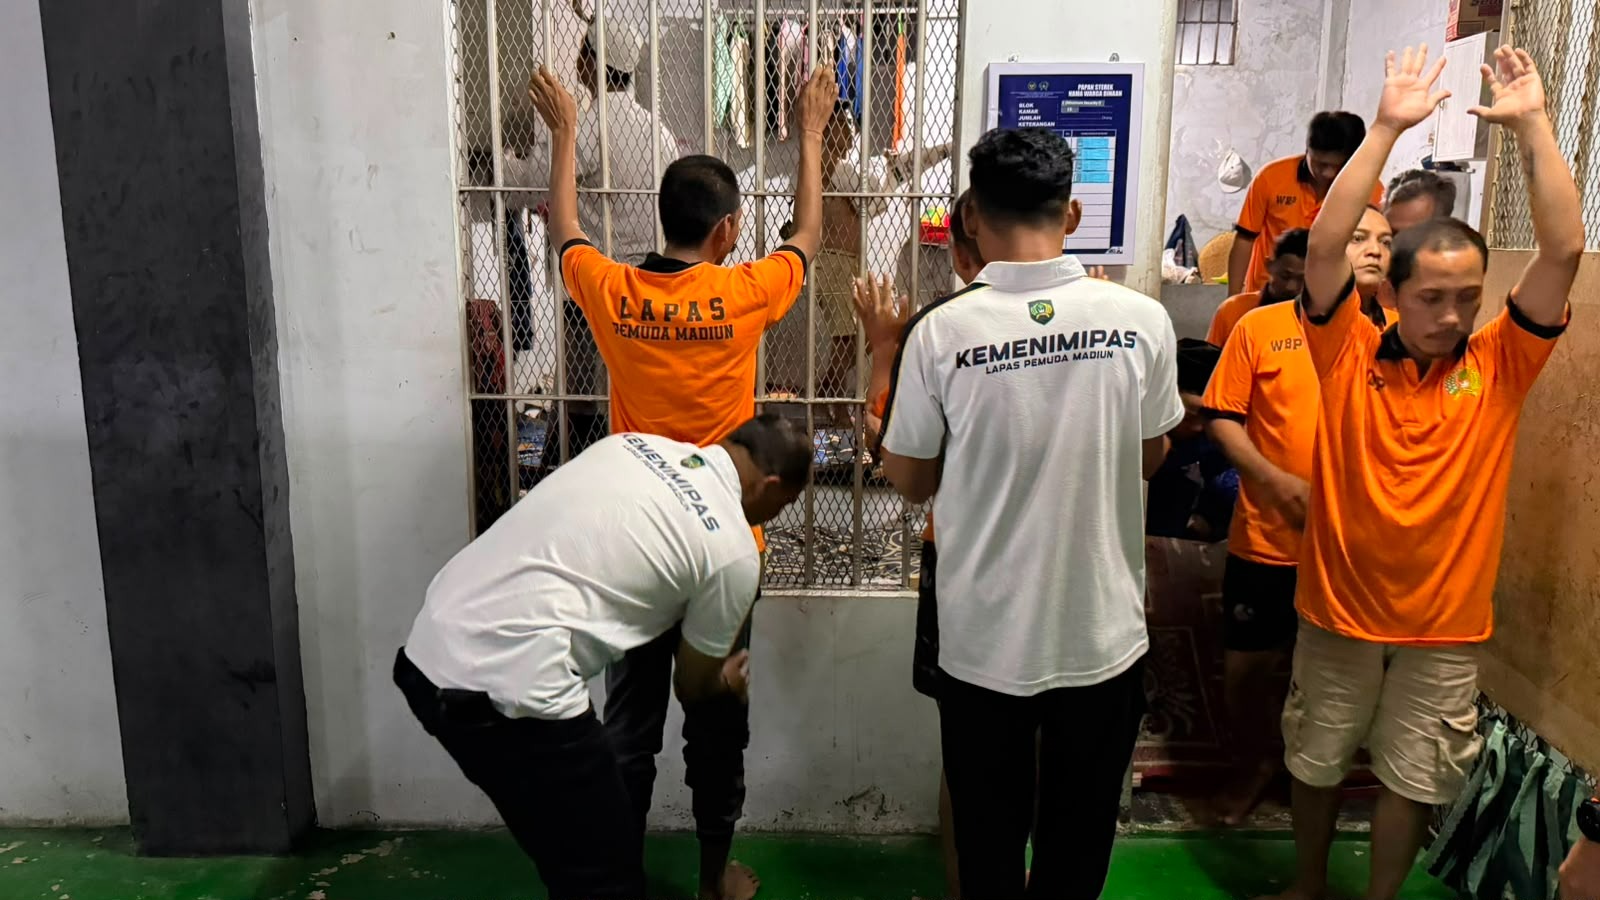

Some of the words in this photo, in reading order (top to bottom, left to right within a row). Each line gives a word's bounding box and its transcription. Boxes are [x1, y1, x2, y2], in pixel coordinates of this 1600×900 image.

[620, 296, 725, 322] LAPAS
[612, 322, 671, 340] PEMUDA
[675, 324, 734, 341] MADIUN
[956, 329, 1138, 369] KEMENIMIPAS
[1270, 337, 1303, 352] WBP
[985, 361, 1020, 375] LAPAS
[1023, 355, 1068, 368] PEMUDA
[1072, 350, 1114, 361] MADIUN
